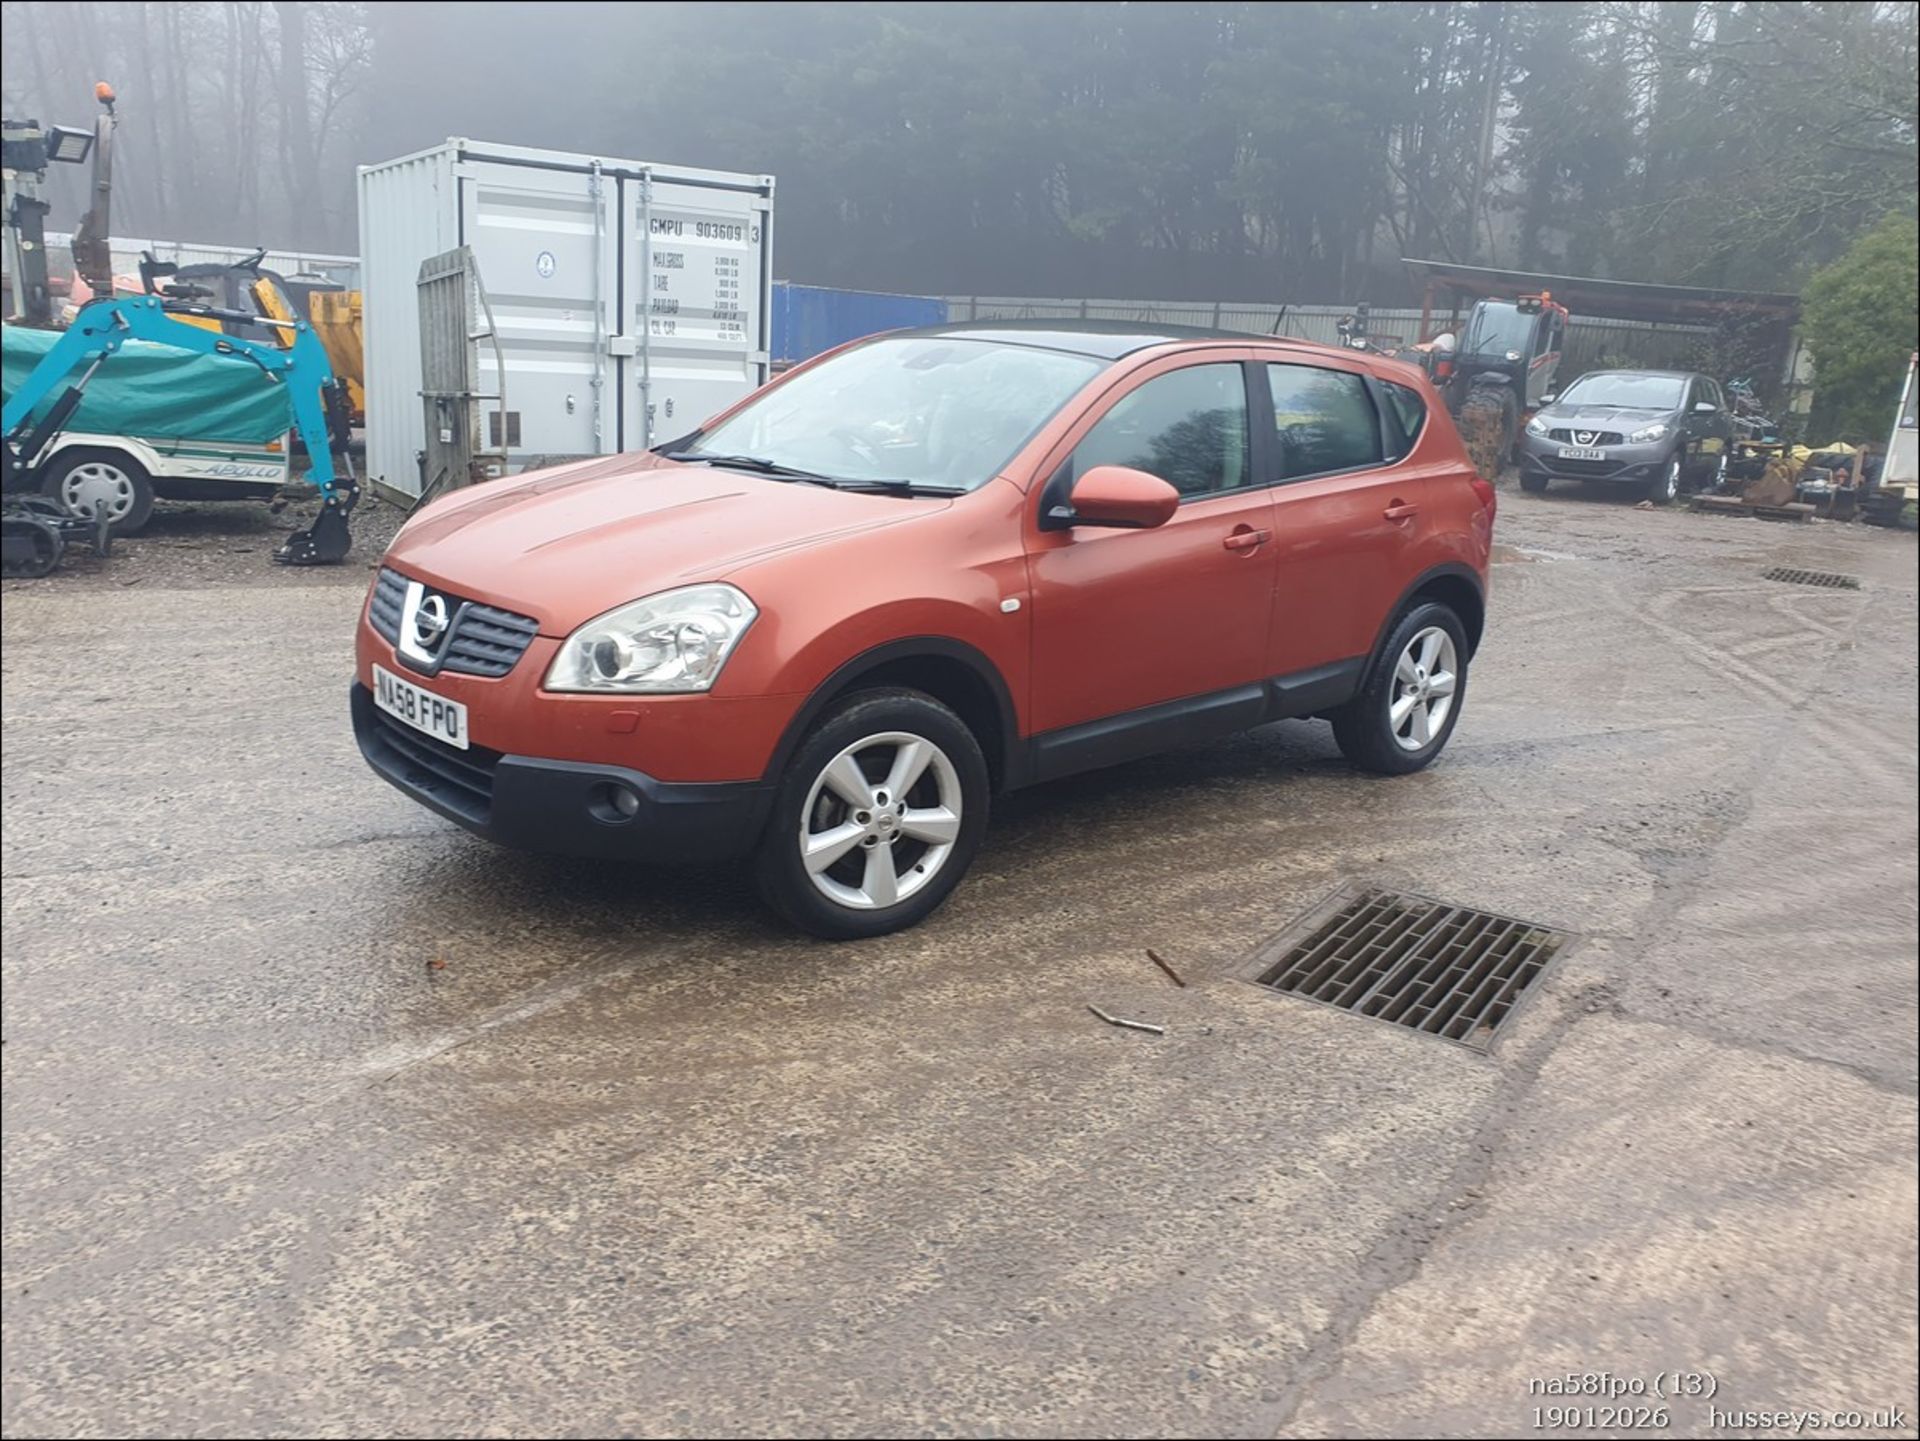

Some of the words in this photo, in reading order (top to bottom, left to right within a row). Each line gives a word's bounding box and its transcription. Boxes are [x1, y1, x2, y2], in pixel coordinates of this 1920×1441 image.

[650, 218, 683, 236] GMPU
[696, 222, 742, 241] 903609
[751, 226, 760, 243] 3
[653, 274, 668, 291] TARE
[652, 298, 679, 314] PAYLOAD
[205, 464, 280, 478] APOLLO
[378, 668, 415, 720] NA58
[420, 694, 457, 738] FPO
